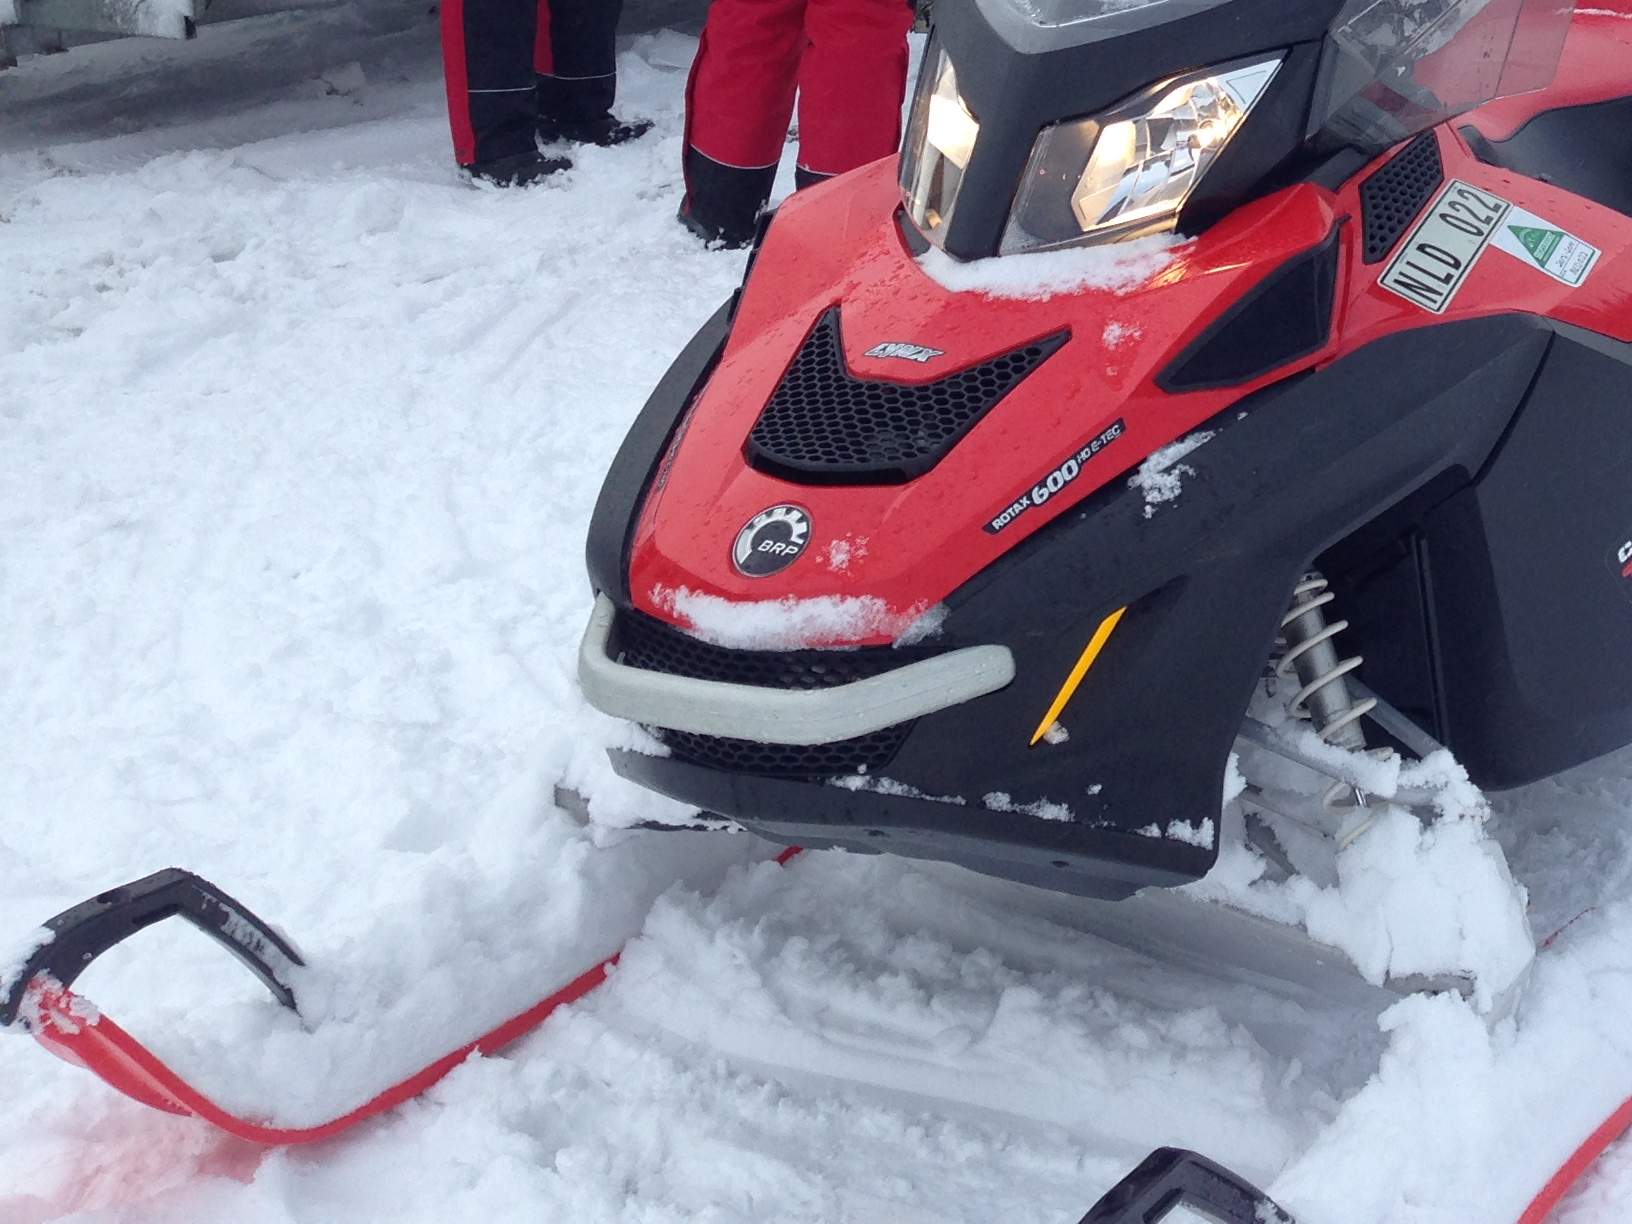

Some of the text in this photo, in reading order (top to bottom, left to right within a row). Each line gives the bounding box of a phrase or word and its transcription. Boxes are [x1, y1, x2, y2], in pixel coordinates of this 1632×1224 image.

[1393, 188, 1503, 304] NLD 022
[863, 342, 946, 363] LYNX
[992, 495, 1031, 530] ROTAX
[1031, 459, 1079, 505] 600
[757, 539, 799, 556] BRP
